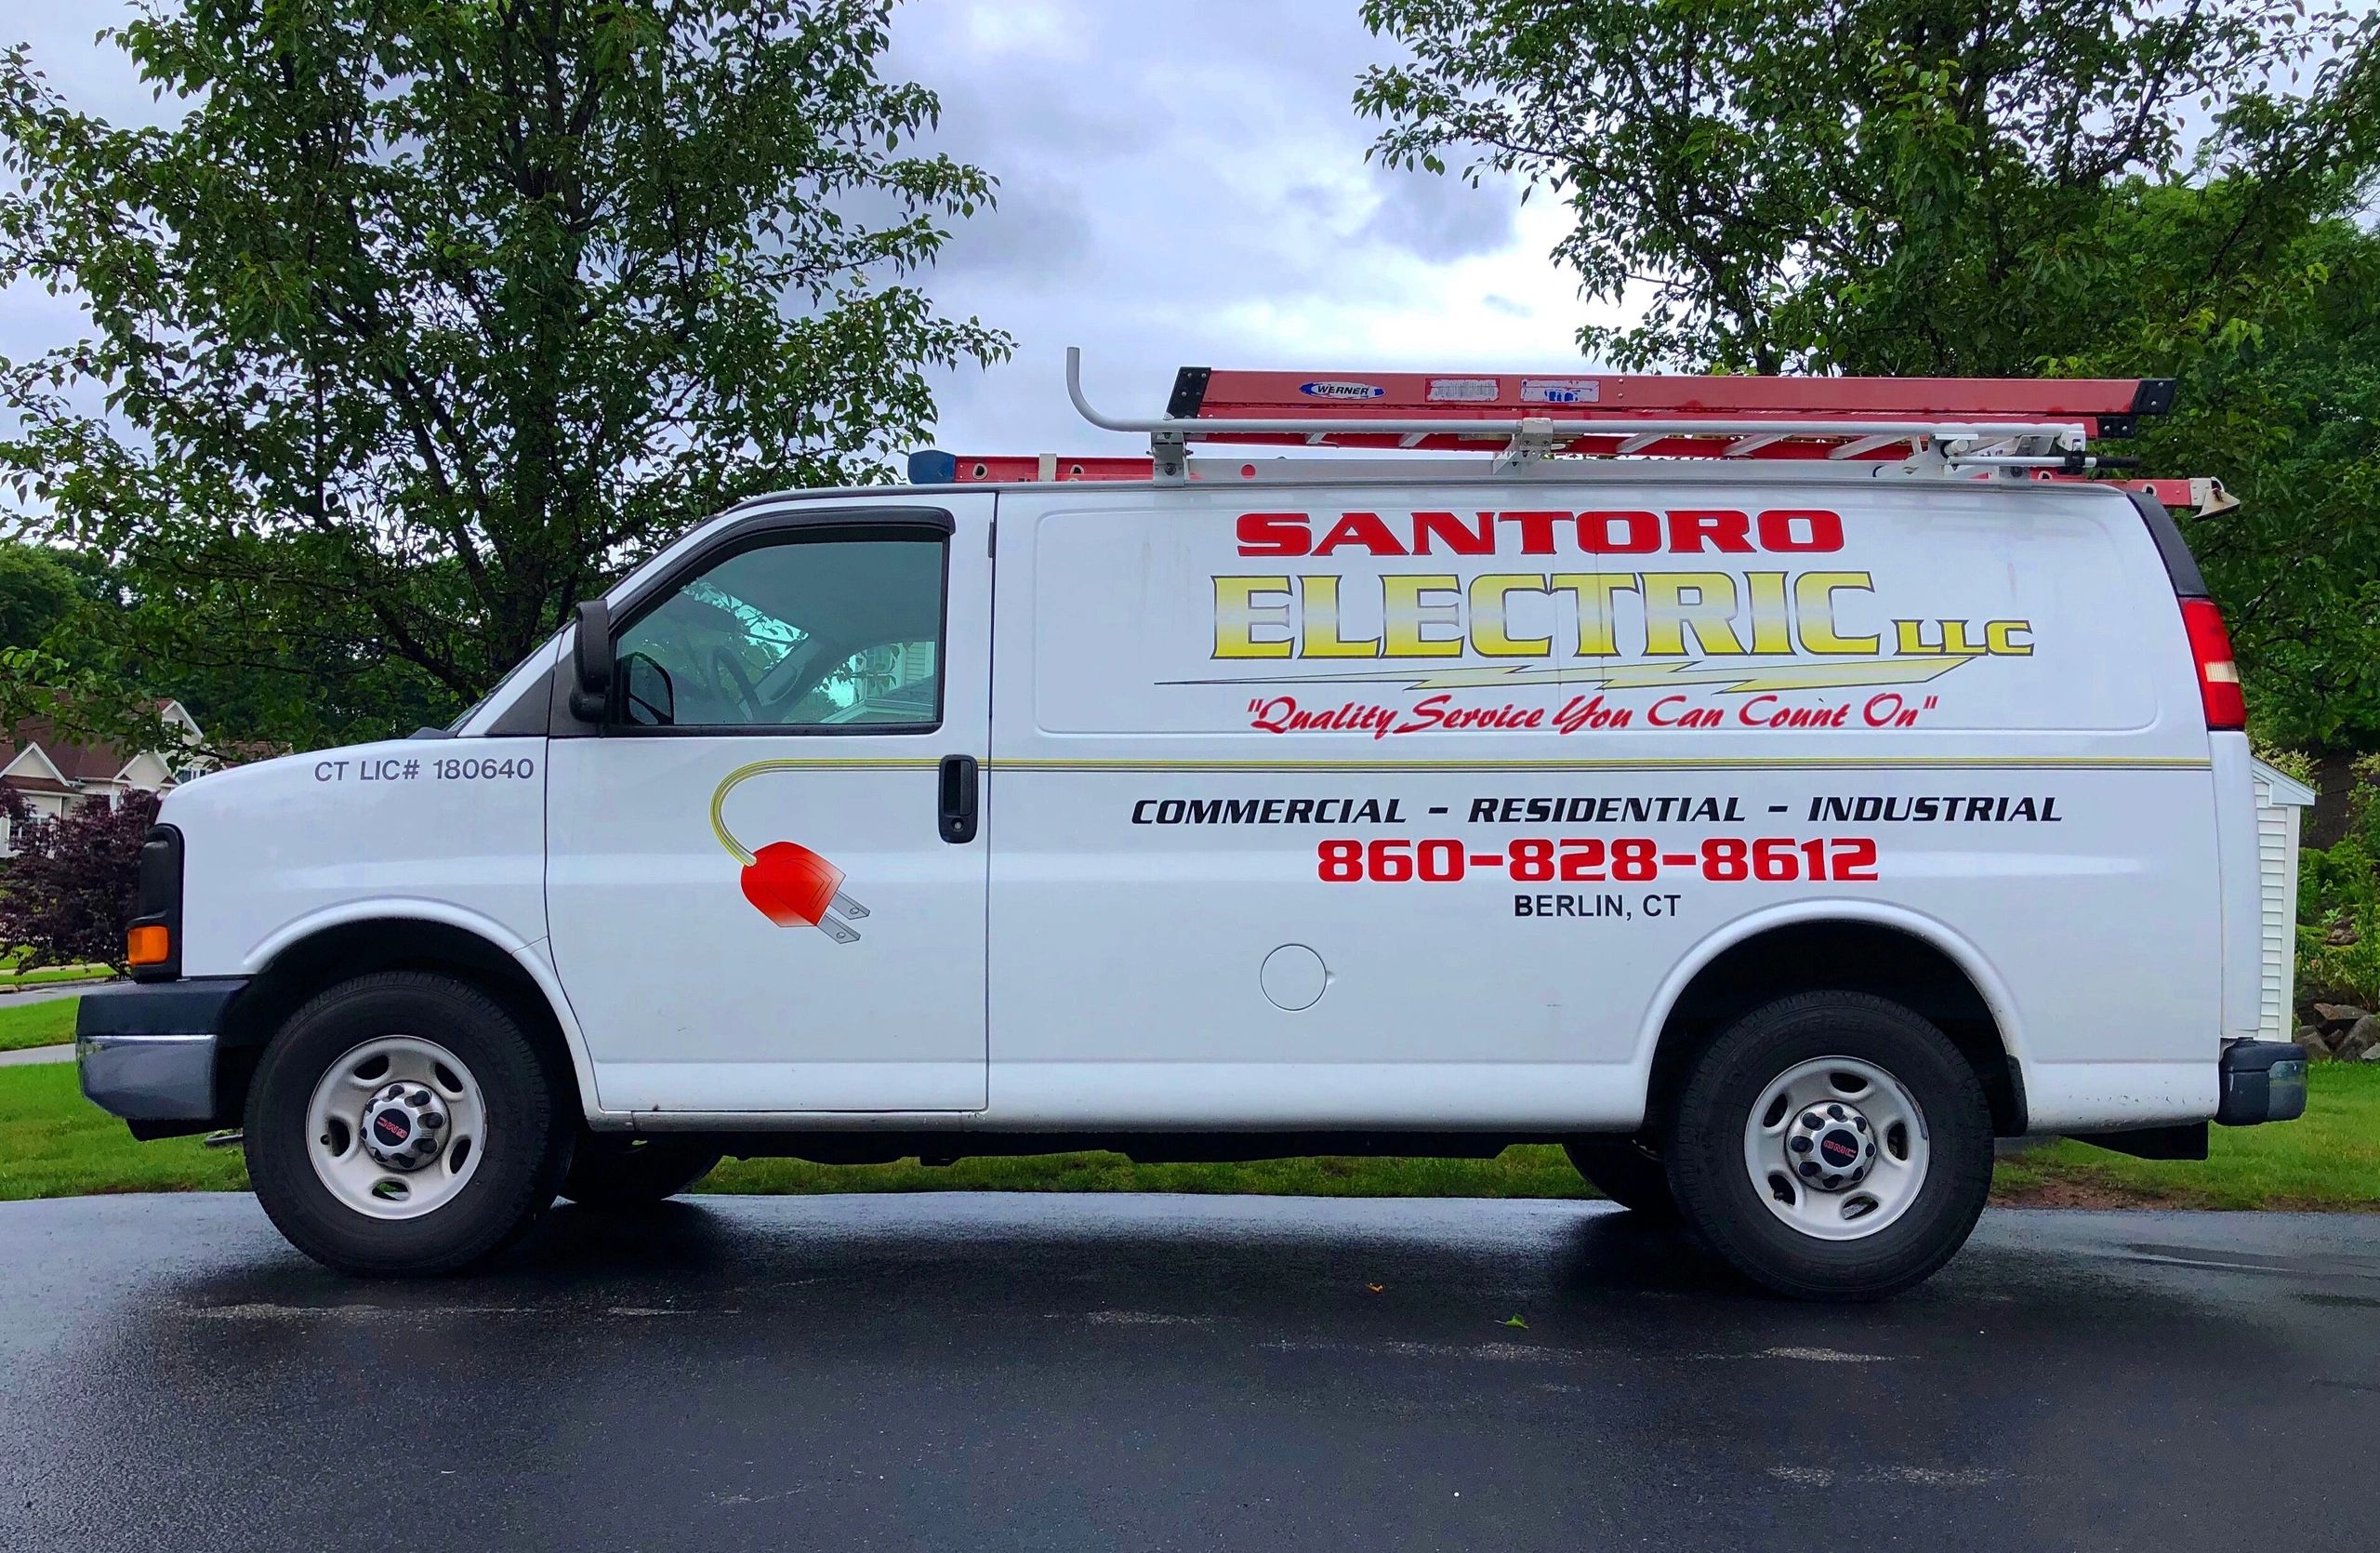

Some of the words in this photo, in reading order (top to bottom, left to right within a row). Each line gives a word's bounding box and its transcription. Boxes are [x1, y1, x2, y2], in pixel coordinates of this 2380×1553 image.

[1317, 385, 1369, 395] WERNER
[1236, 510, 1844, 557] SANTORO
[1210, 571, 1881, 660] ELECTRIC
[1891, 620, 2035, 657] LLC
[1247, 696, 1399, 740] "Quality
[1393, 695, 1545, 734] Service
[1552, 695, 1633, 736] You
[1646, 695, 1725, 728] Can
[1738, 695, 1851, 729] Count
[1863, 693, 1939, 728] On"
[314, 761, 350, 782] CT
[360, 759, 420, 781] LIC#
[433, 758, 535, 780] 180640
[1131, 799, 1408, 826] COMMERCIAL
[1468, 797, 1747, 824] RESIDENTIAL
[1807, 796, 2063, 823] INDUSTRIAL
[1317, 838, 1880, 884] 860-828-8612
[1514, 896, 1633, 923] BERLIN,
[1642, 895, 1683, 919] CT
[377, 1116, 408, 1139] GMC
[1823, 1139, 1857, 1159] GMC
